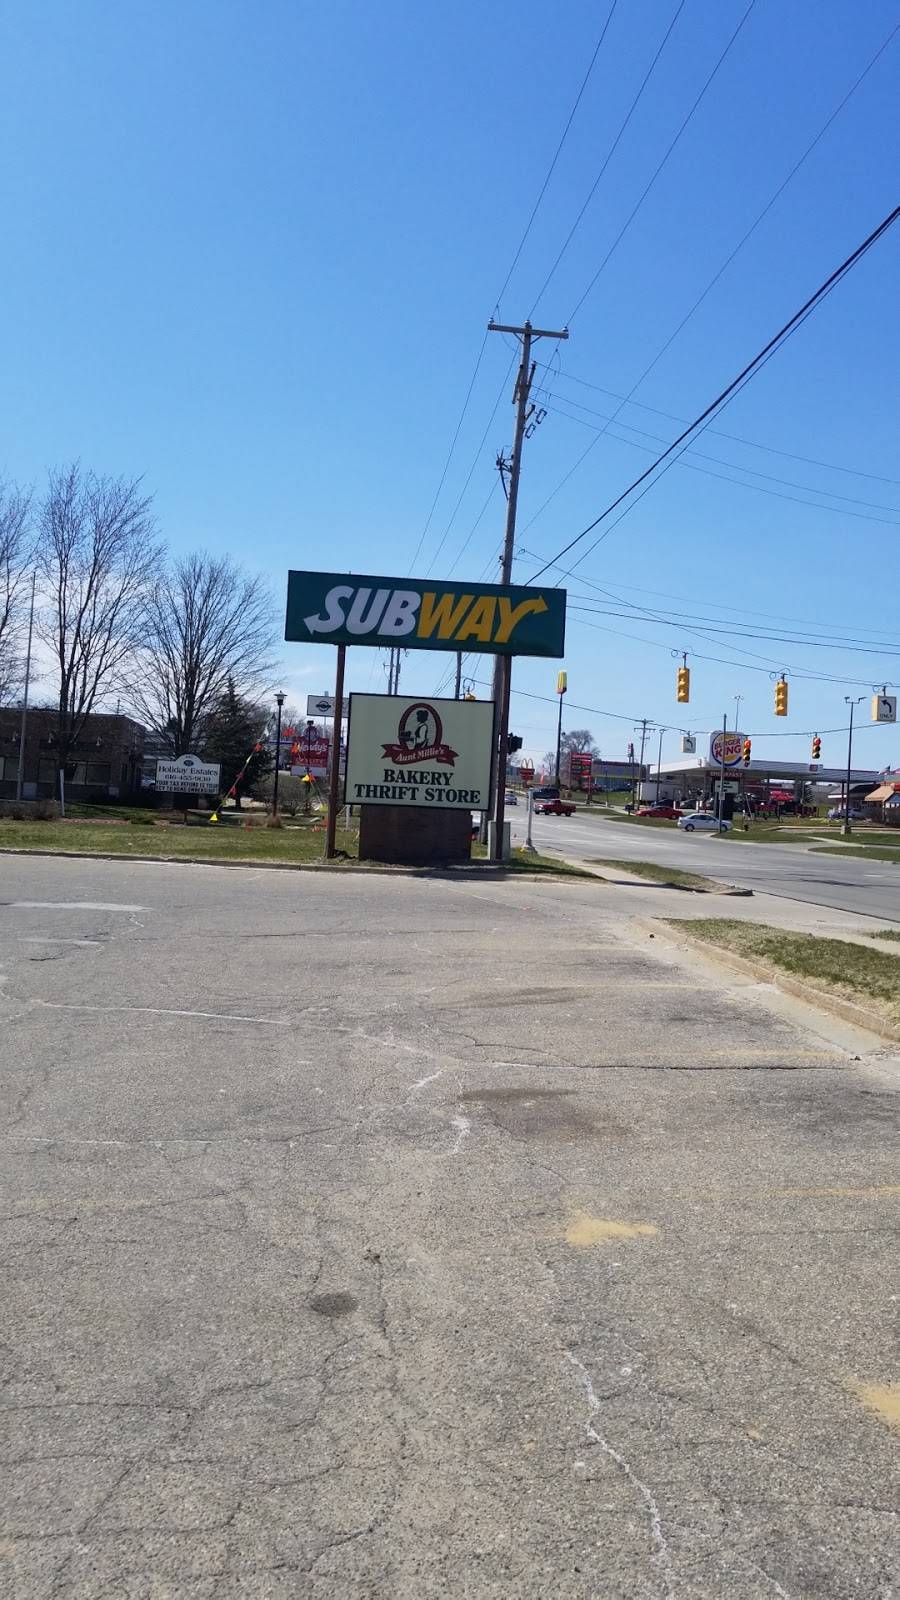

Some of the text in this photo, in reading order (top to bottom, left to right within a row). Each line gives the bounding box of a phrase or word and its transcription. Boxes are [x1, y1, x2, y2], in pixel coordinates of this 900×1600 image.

[304, 585, 548, 643] SUBWAY
[395, 746, 445, 762] Aunt Millie's
[715, 744, 742, 759] KNG
[158, 765, 218, 777] Holiday Estates
[383, 769, 454, 786] BAKERY
[354, 784, 481, 804] THRIFT STORE
